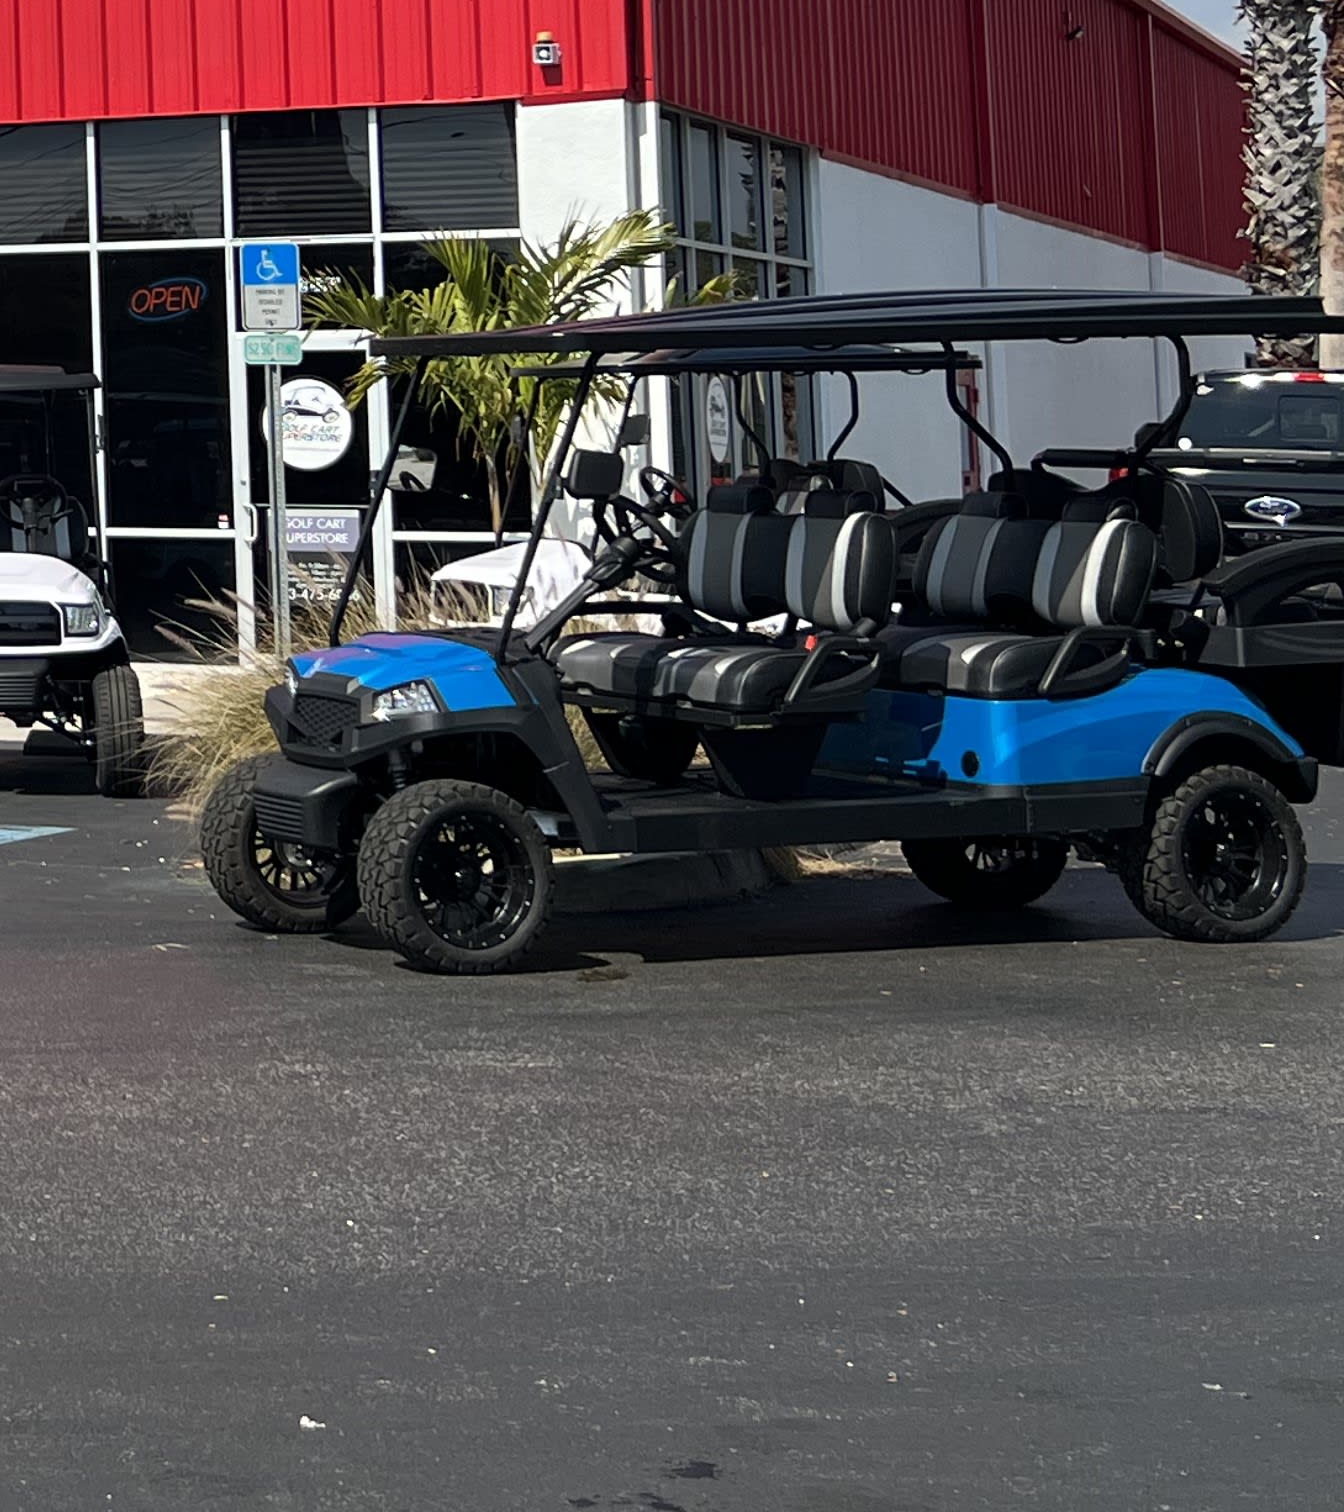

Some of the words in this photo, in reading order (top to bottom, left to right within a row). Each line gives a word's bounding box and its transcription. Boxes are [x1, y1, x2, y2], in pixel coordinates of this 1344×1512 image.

[131, 285, 201, 314] OPEN
[316, 518, 346, 529] CART
[286, 532, 349, 544] UPERSTORE
